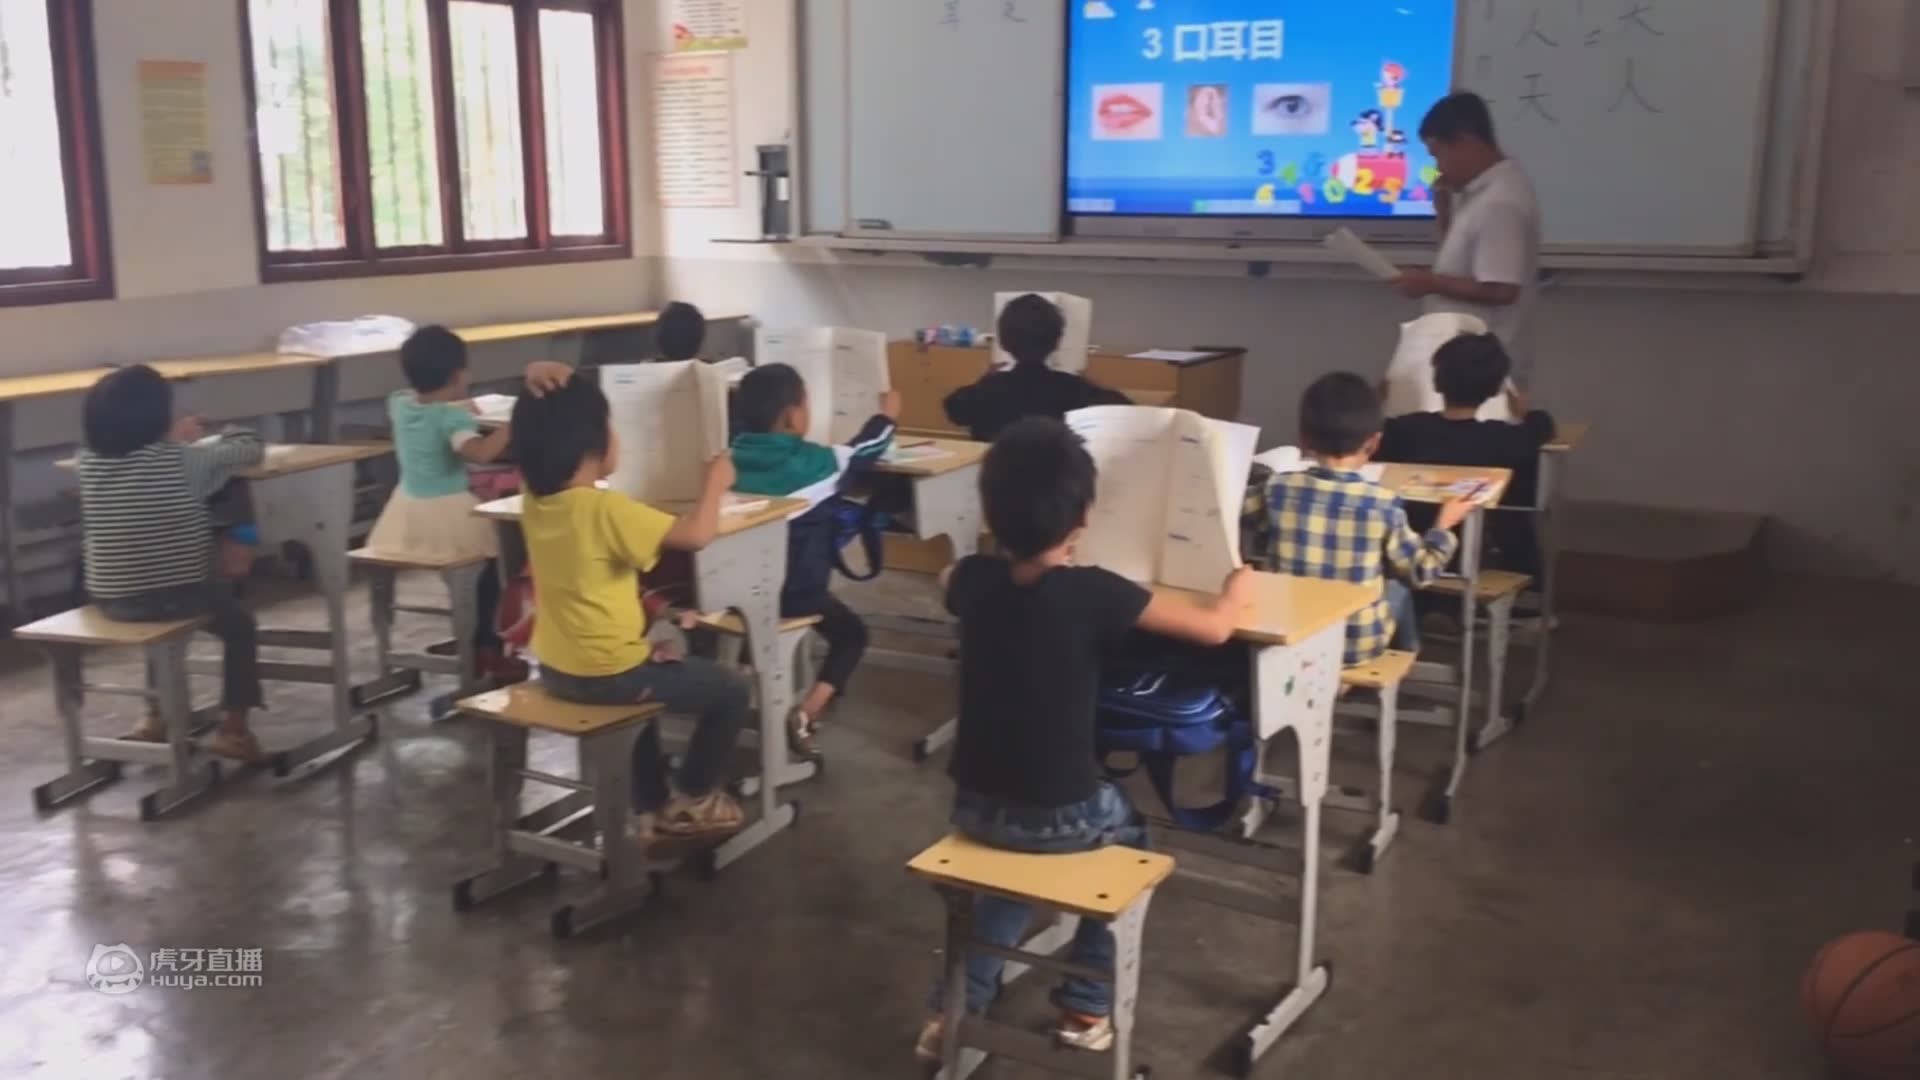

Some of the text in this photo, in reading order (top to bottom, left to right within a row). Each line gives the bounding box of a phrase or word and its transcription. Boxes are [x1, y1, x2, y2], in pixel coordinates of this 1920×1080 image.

[1141, 19, 1284, 61] 3 口耳目
